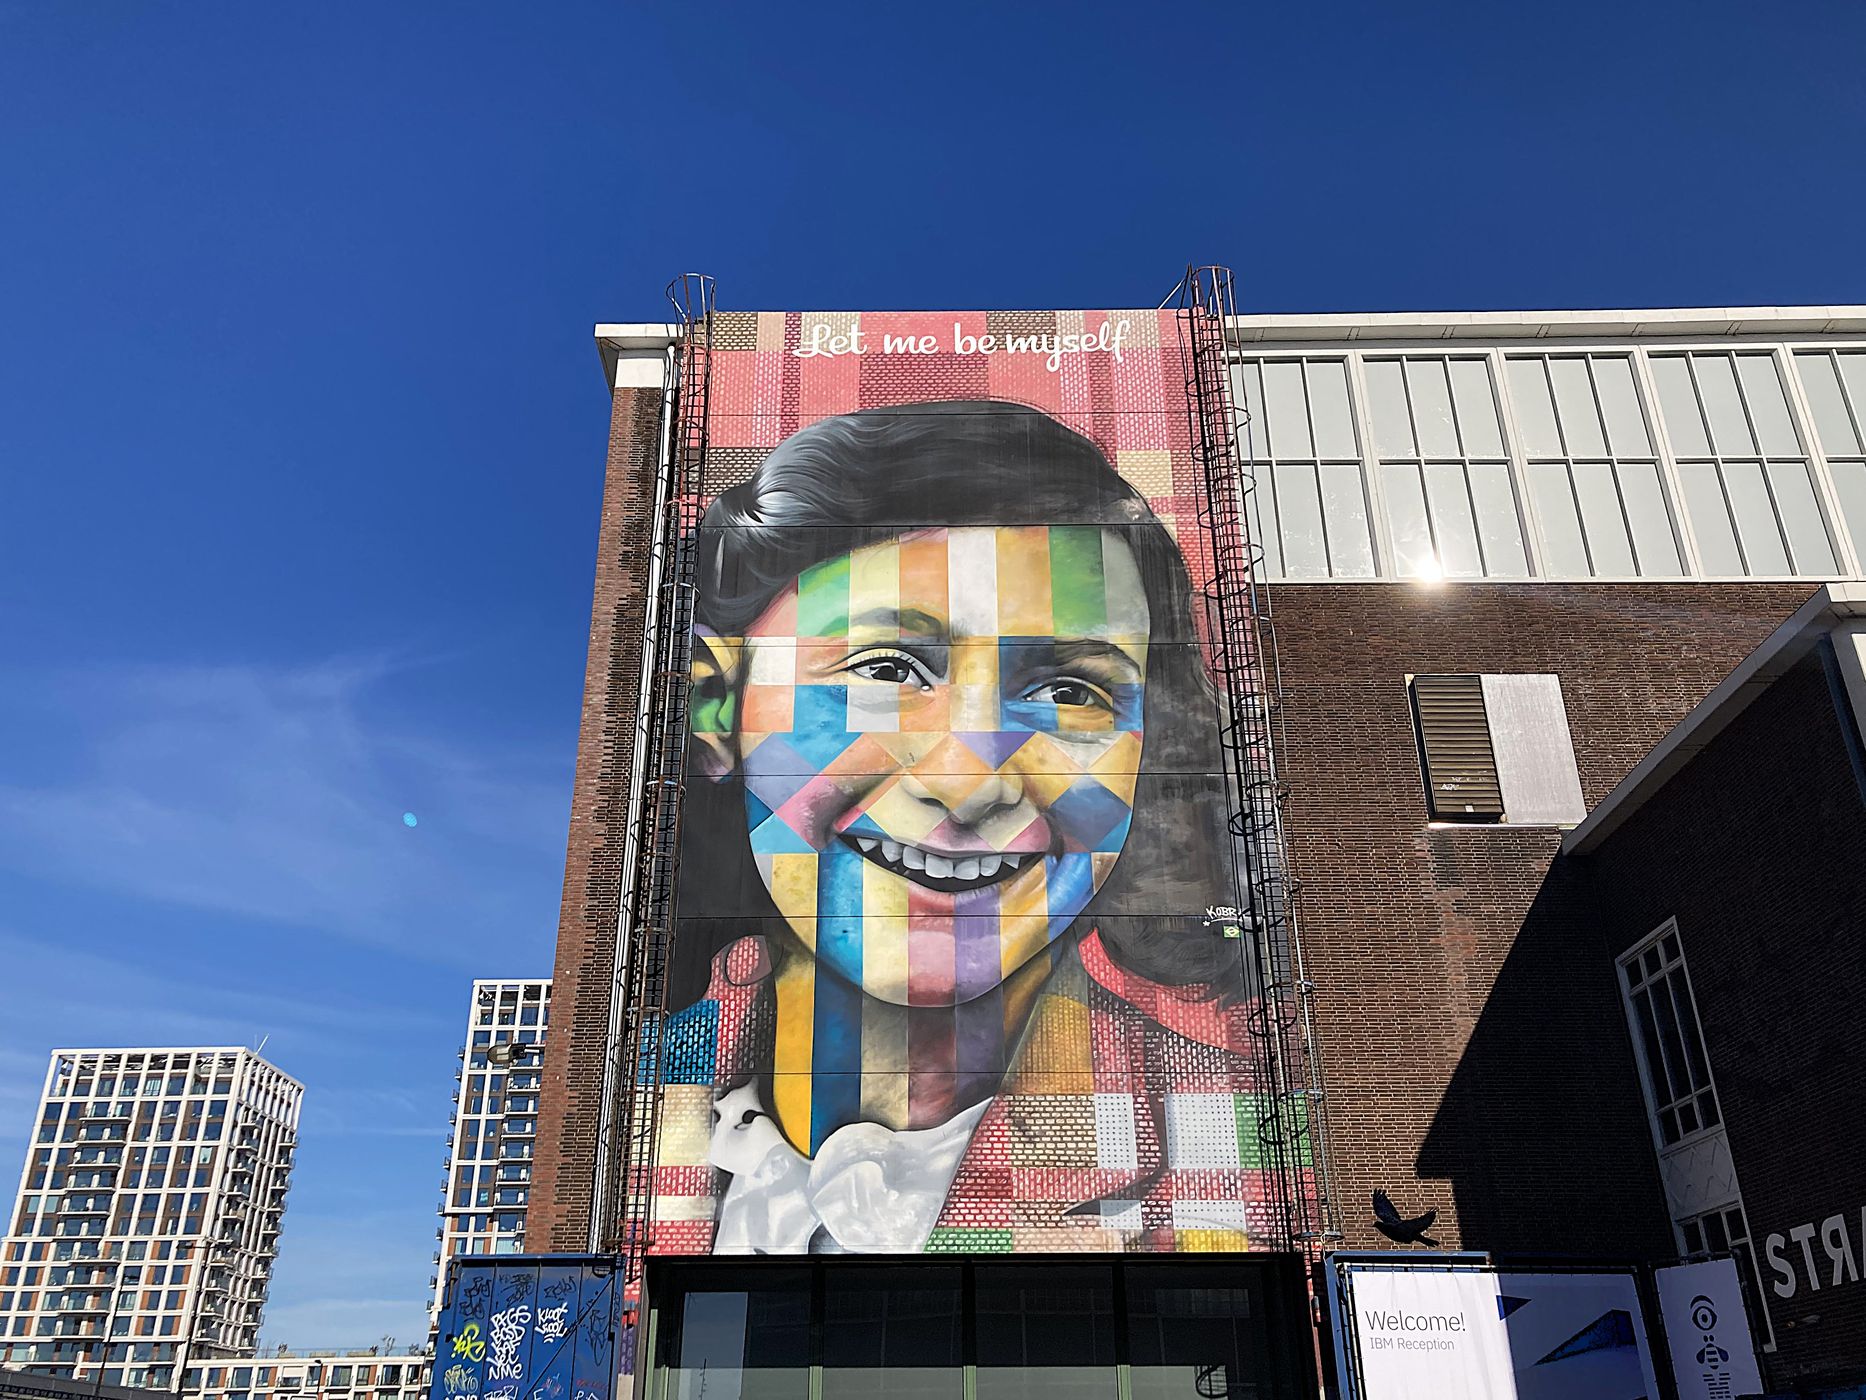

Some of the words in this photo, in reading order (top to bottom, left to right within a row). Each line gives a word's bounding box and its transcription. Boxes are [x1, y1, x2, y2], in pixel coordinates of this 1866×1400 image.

[792, 323, 868, 359] Let
[883, 333, 940, 355] me
[953, 322, 1005, 355] be
[1004, 319, 1131, 372] myself
[1365, 1310, 1466, 1332] Welcome!
[1370, 1337, 1394, 1350] IBM
[1397, 1337, 1455, 1352] Reception
